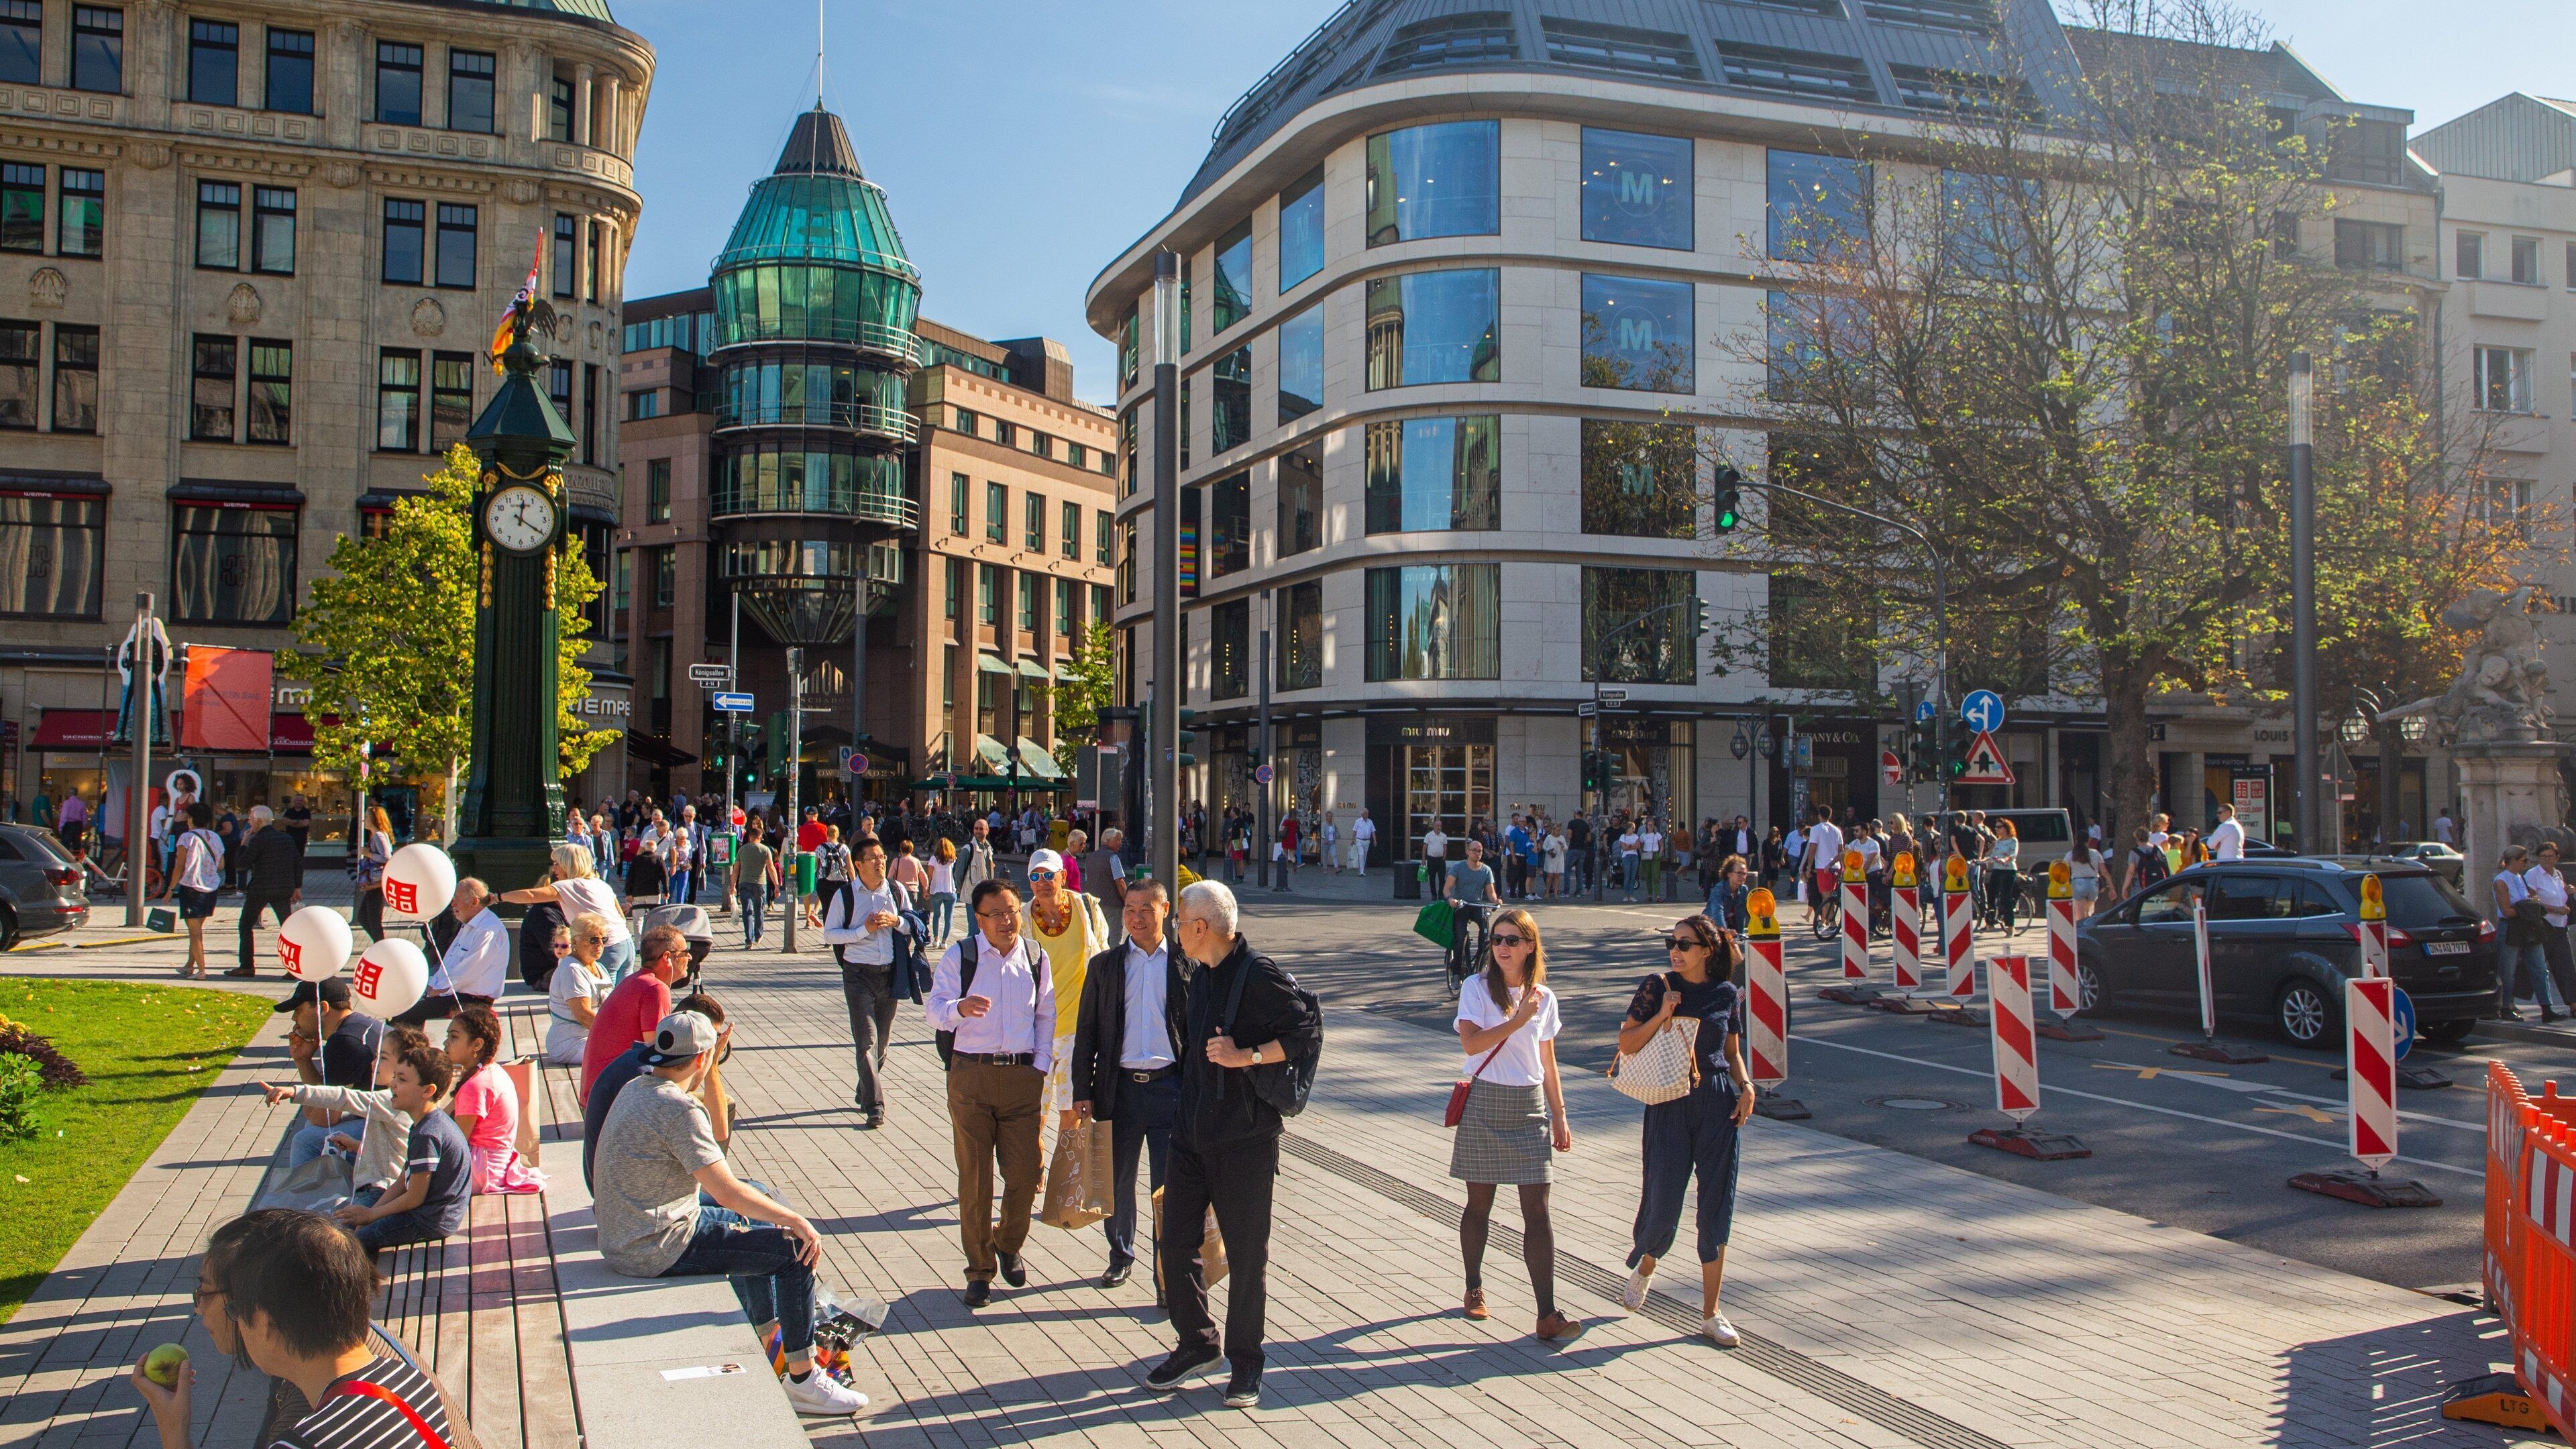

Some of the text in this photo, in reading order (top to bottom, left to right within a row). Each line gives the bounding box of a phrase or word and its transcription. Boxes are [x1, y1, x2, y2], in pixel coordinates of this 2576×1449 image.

[1621, 171, 1653, 205] M
[1620, 318, 1652, 352] M
[695, 668, 724, 677] Königsallee
[1401, 727, 1450, 737] MIU MIU
[2255, 730, 2289, 741] LOUIS
[278, 941, 295, 960] UNI
